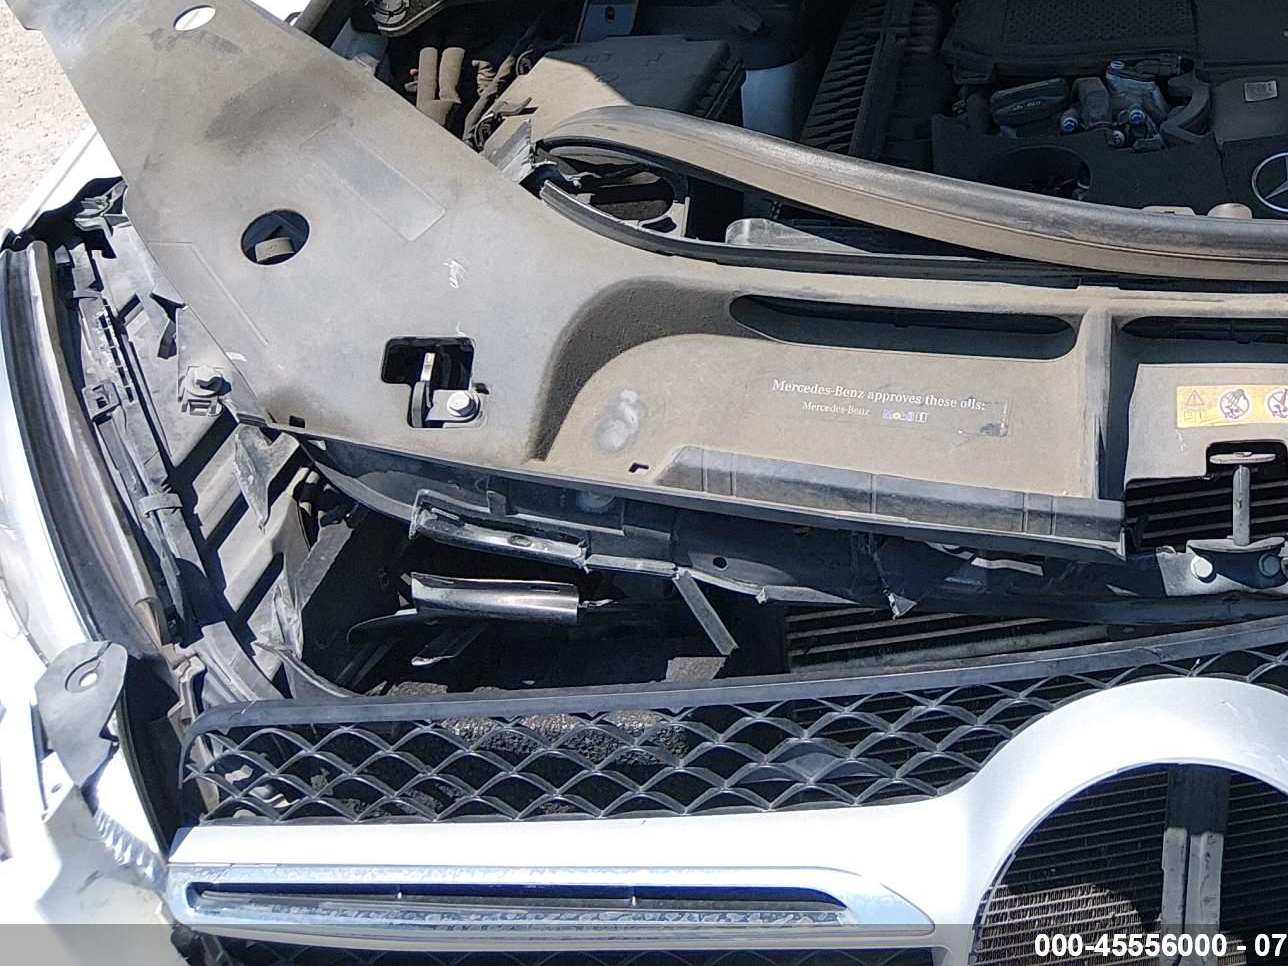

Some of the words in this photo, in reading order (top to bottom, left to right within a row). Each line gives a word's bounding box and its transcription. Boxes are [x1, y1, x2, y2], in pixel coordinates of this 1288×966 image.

[772, 379, 865, 399] Mercedes-Benz
[867, 391, 922, 404] approves
[925, 394, 957, 408] these
